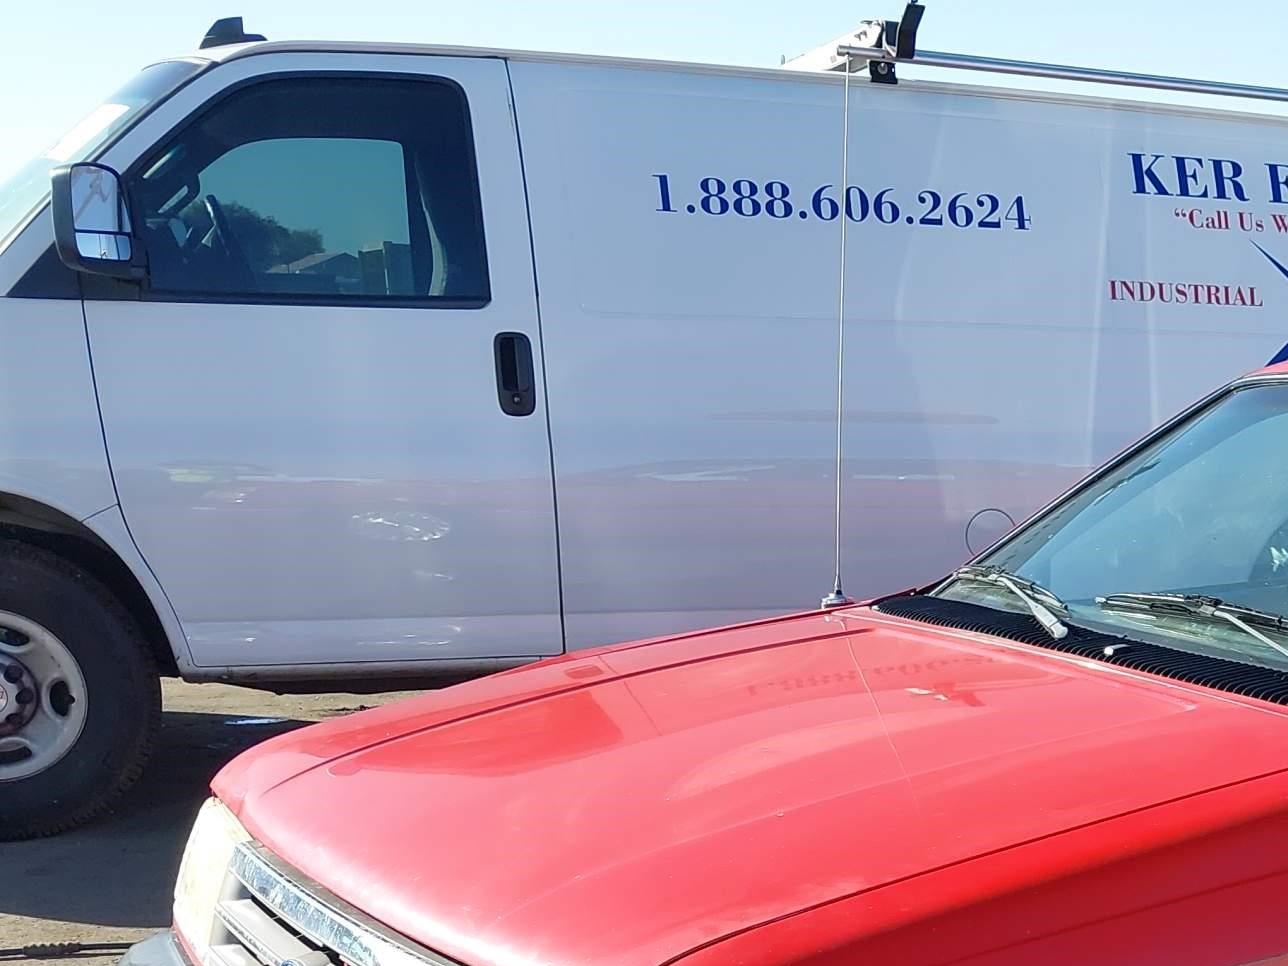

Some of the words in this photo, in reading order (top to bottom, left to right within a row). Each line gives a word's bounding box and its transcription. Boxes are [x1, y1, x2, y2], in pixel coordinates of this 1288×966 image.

[1127, 152, 1250, 202] KER
[651, 174, 1032, 231] 1.888.606.2624
[1238, 211, 1265, 233] Us
[1109, 279, 1263, 307] INDUSTRIAL
